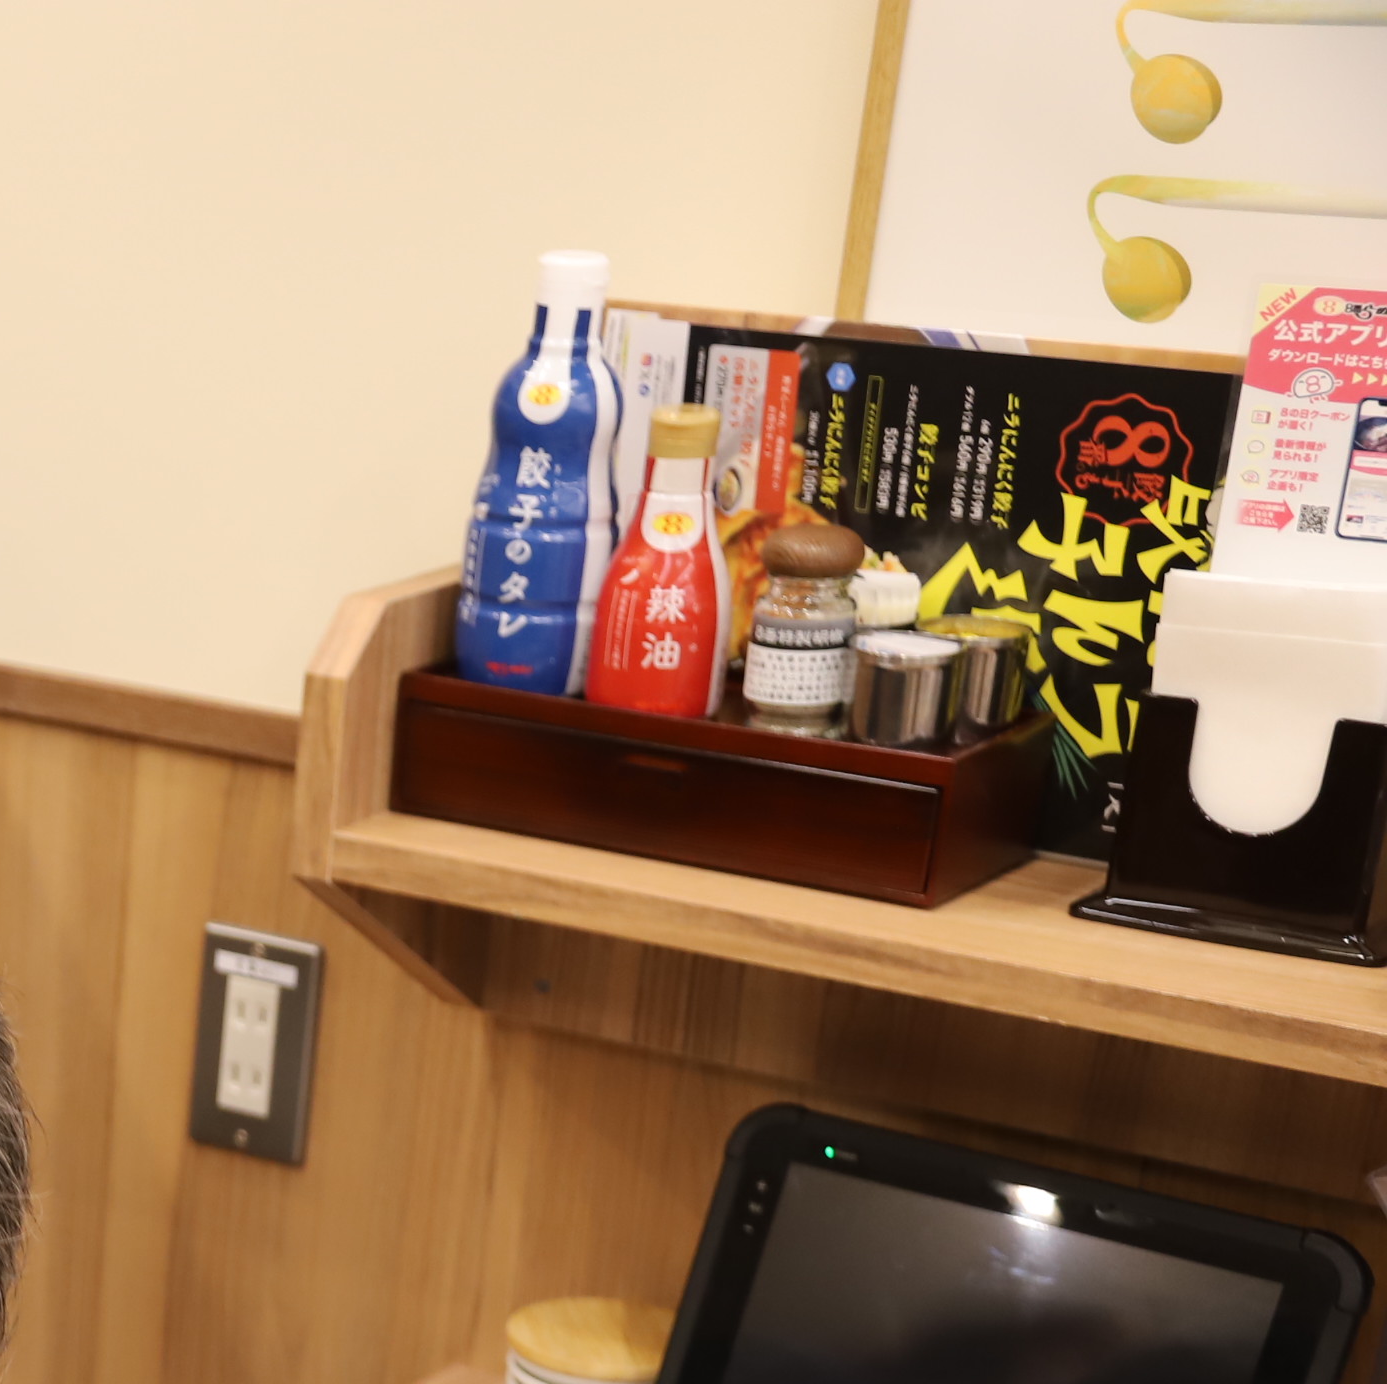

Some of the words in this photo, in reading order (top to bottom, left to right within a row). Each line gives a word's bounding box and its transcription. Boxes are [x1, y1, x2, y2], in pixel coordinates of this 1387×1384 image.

[1259, 288, 1298, 322] NEW
[1268, 348, 1387, 370] ダウンロードはこち
[910, 423, 940, 522] 餃子コンビ
[990, 392, 1021, 530] ニラにんにく餃子
[495, 445, 553, 639] 餃子のタレ
[640, 583, 687, 670] 辣油
